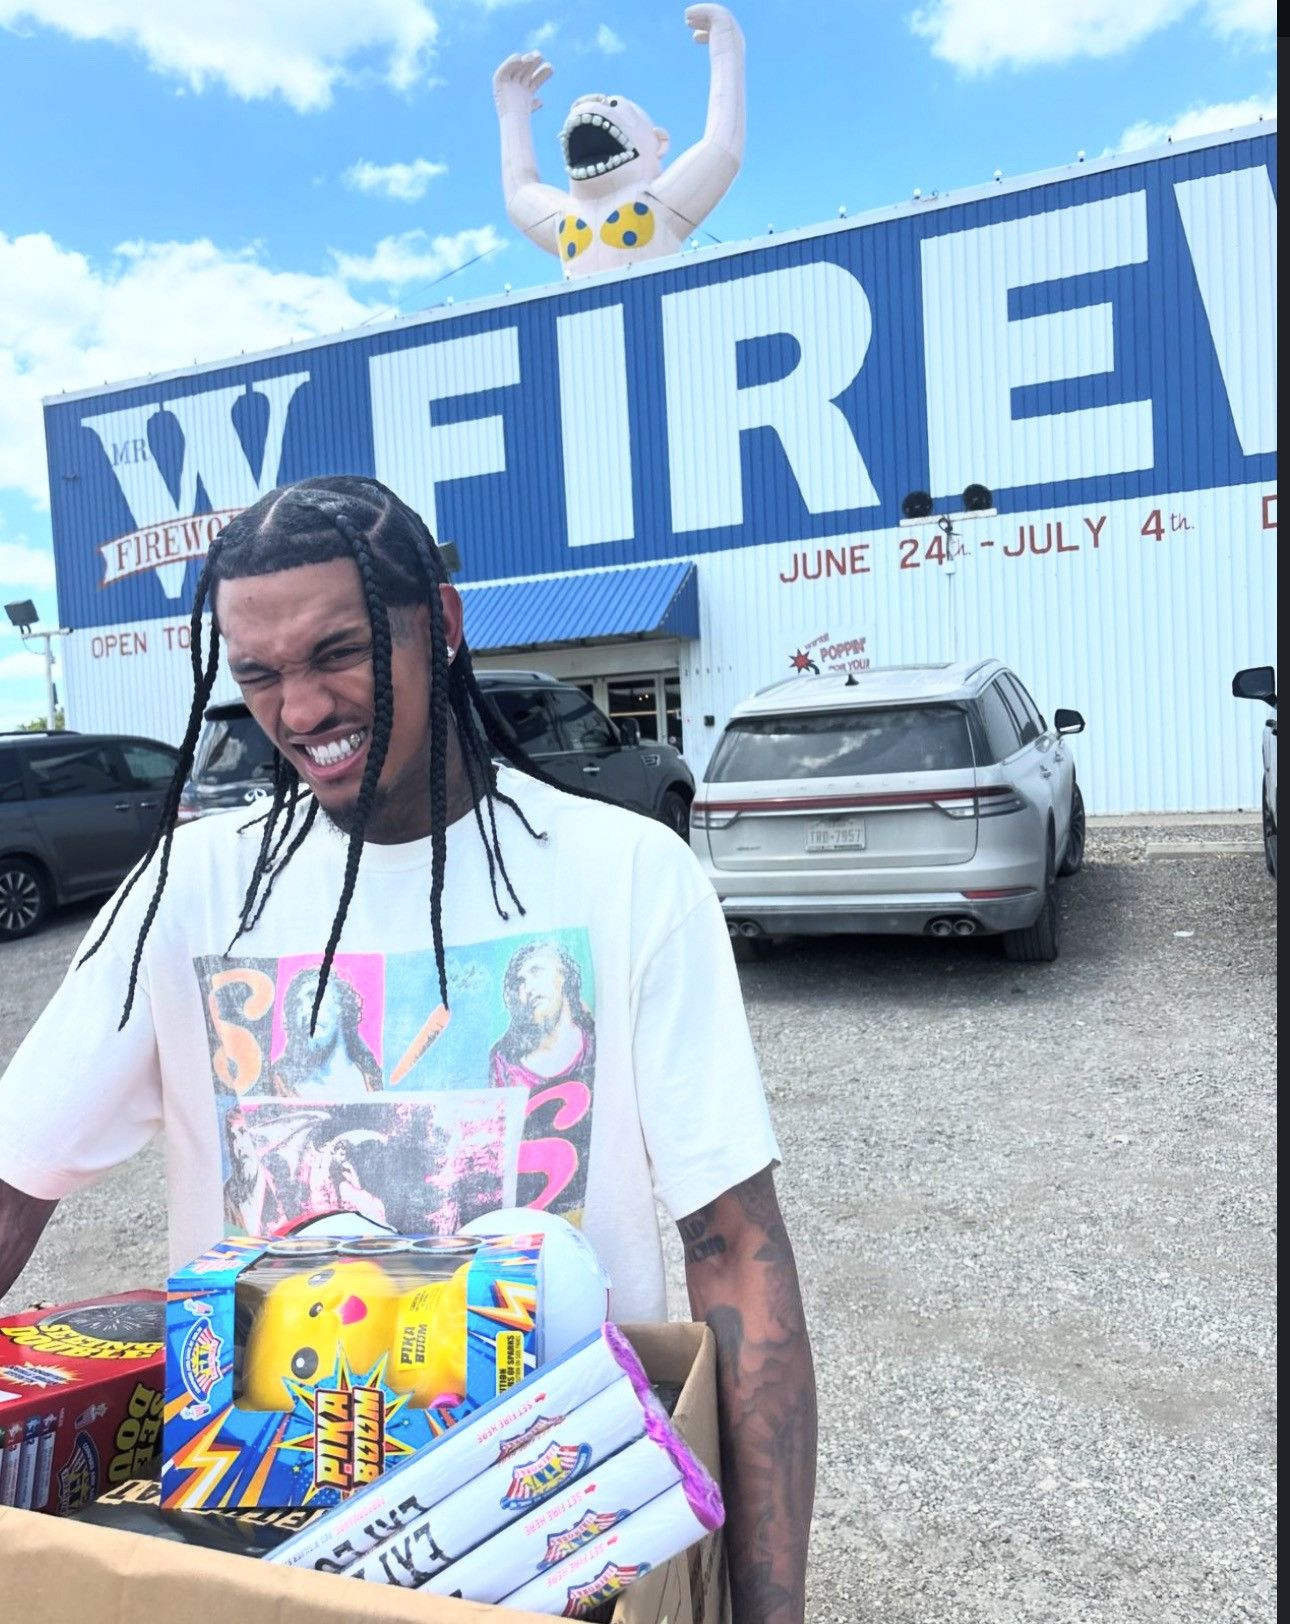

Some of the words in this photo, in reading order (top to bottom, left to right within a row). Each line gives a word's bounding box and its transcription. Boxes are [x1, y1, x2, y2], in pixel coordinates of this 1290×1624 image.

[116, 515, 236, 571] FIREWO
[780, 544, 871, 583] JUNE
[92, 631, 147, 659] OPEN
[163, 625, 191, 651] TO
[0, 1325, 158, 1360] DOUBLE
[401, 1326, 415, 1365] PIKA
[316, 1389, 353, 1488] PIKA
[353, 1387, 384, 1488] BOOM
